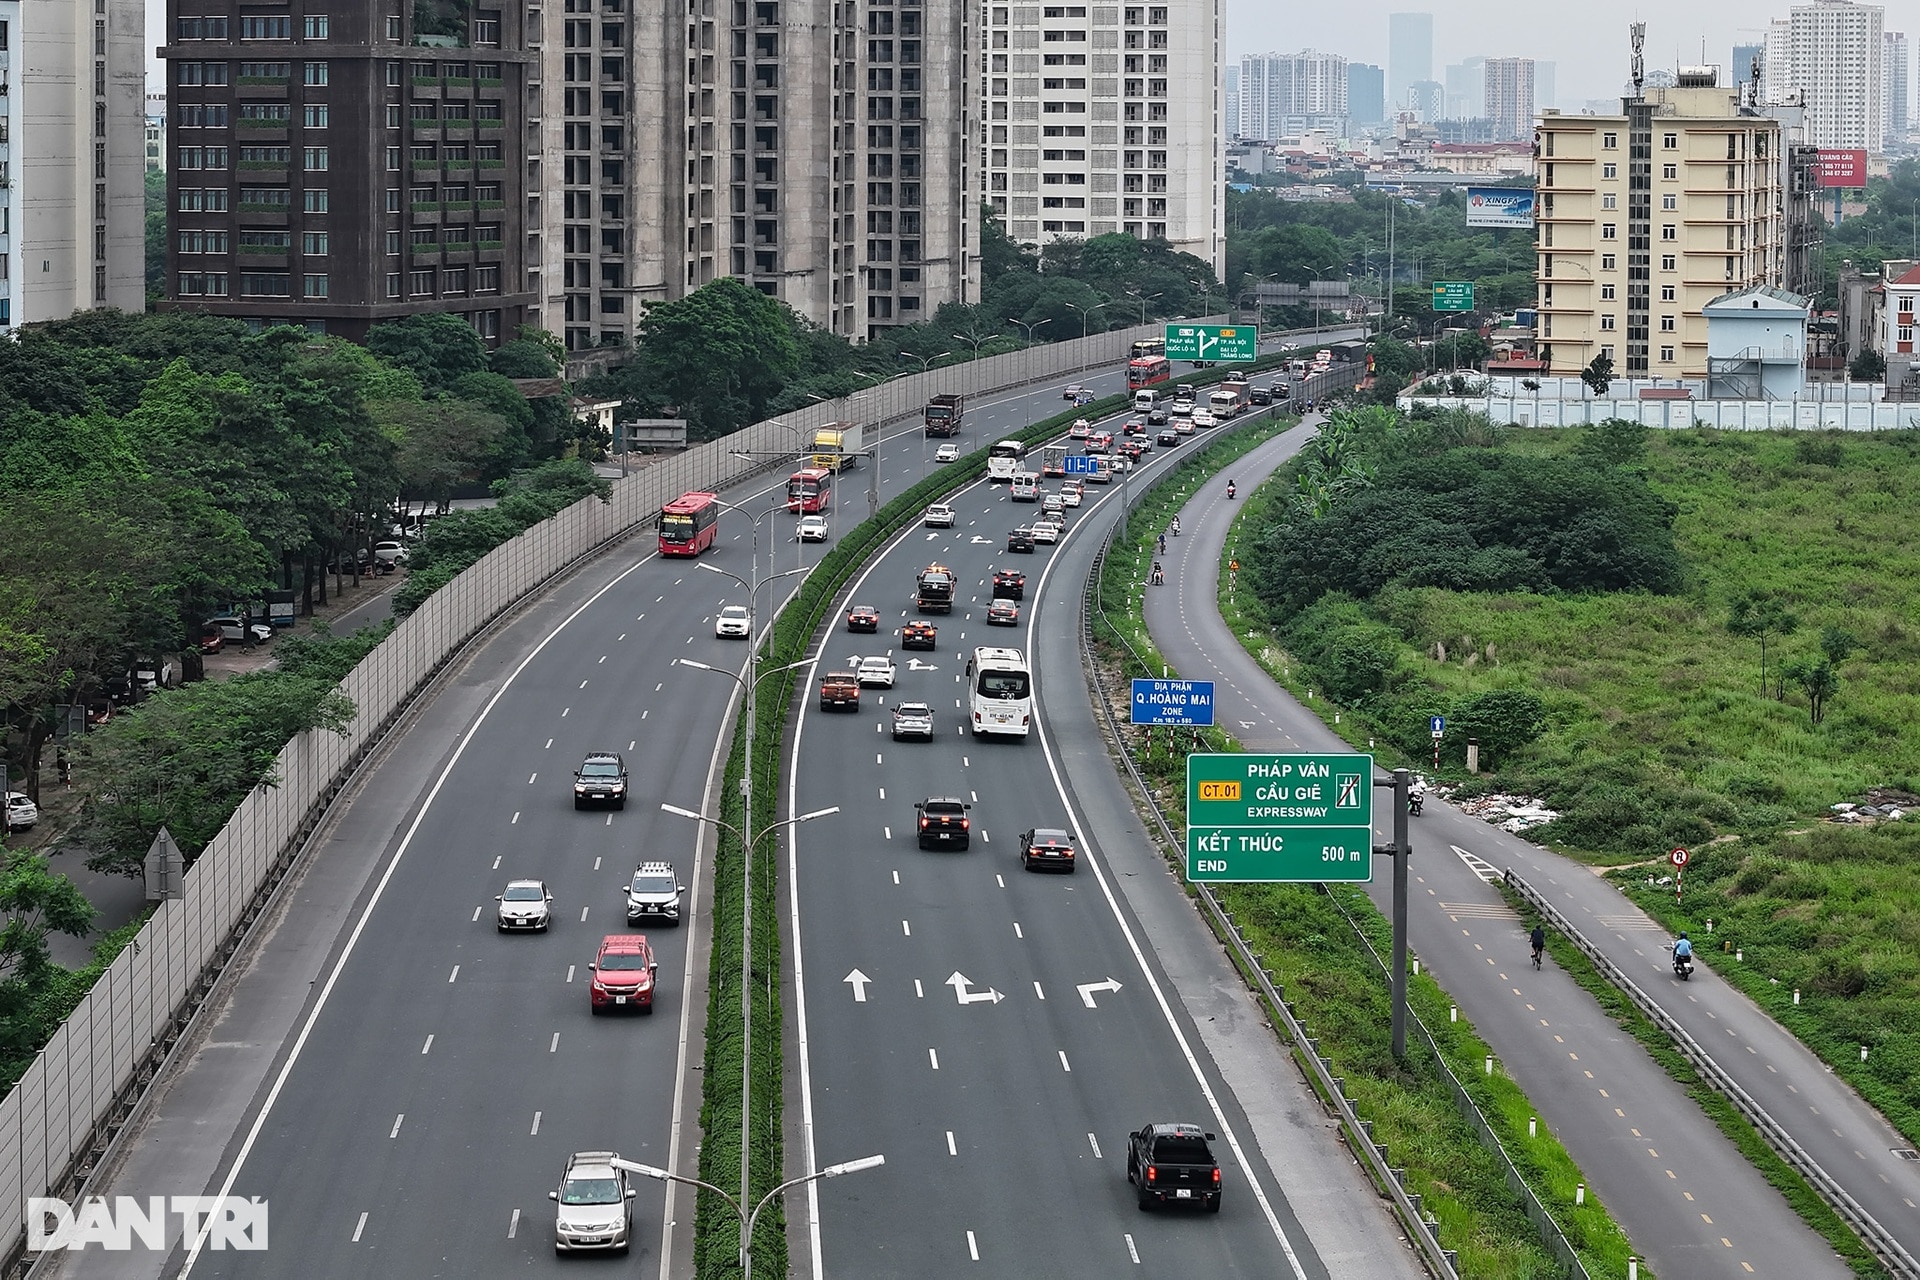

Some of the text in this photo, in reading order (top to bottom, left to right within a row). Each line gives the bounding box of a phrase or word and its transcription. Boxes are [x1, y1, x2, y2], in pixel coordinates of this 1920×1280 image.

[43, 260, 50, 272] A1
[1155, 681, 1192, 693] ĐỊA PHẬN
[1136, 691, 1209, 705] Q.HOÀNG MAI
[1162, 707, 1183, 716] ZONE
[1248, 759, 1329, 777] PHÁP VÂN
[1204, 785, 1236, 797] CT.01
[1256, 781, 1321, 800] CẦU GIẼ
[1248, 807, 1328, 817] EXPRESSWAY
[1198, 830, 1283, 851] KẾT THÚC
[1322, 847, 1360, 861] 500 m
[1198, 860, 1227, 871] END
